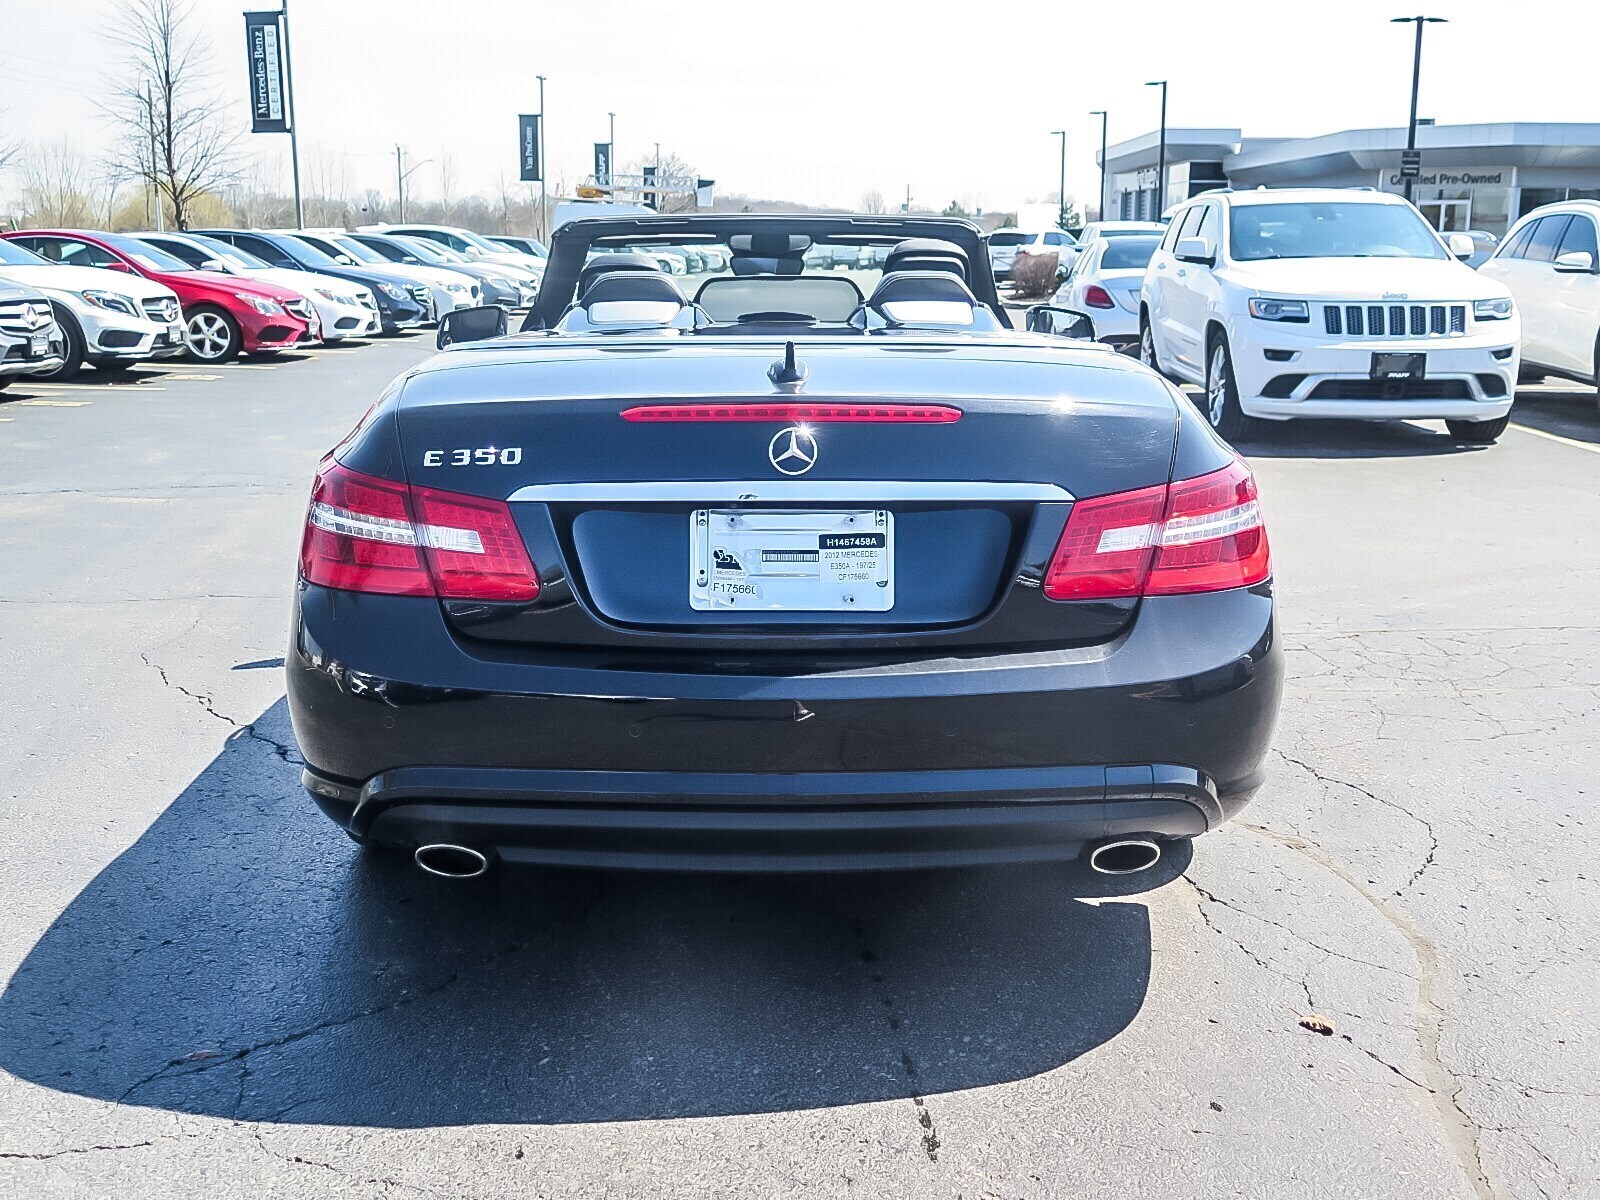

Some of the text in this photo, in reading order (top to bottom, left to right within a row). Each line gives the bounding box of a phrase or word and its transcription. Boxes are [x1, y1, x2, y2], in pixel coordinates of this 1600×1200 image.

[254, 30, 268, 115] Mercedes-Benz
[267, 30, 279, 115] CERTIFIED
[1390, 172, 1502, 185] Ceiied Pre-Owned
[423, 447, 522, 467] E 350
[827, 537, 877, 547] H1467458A
